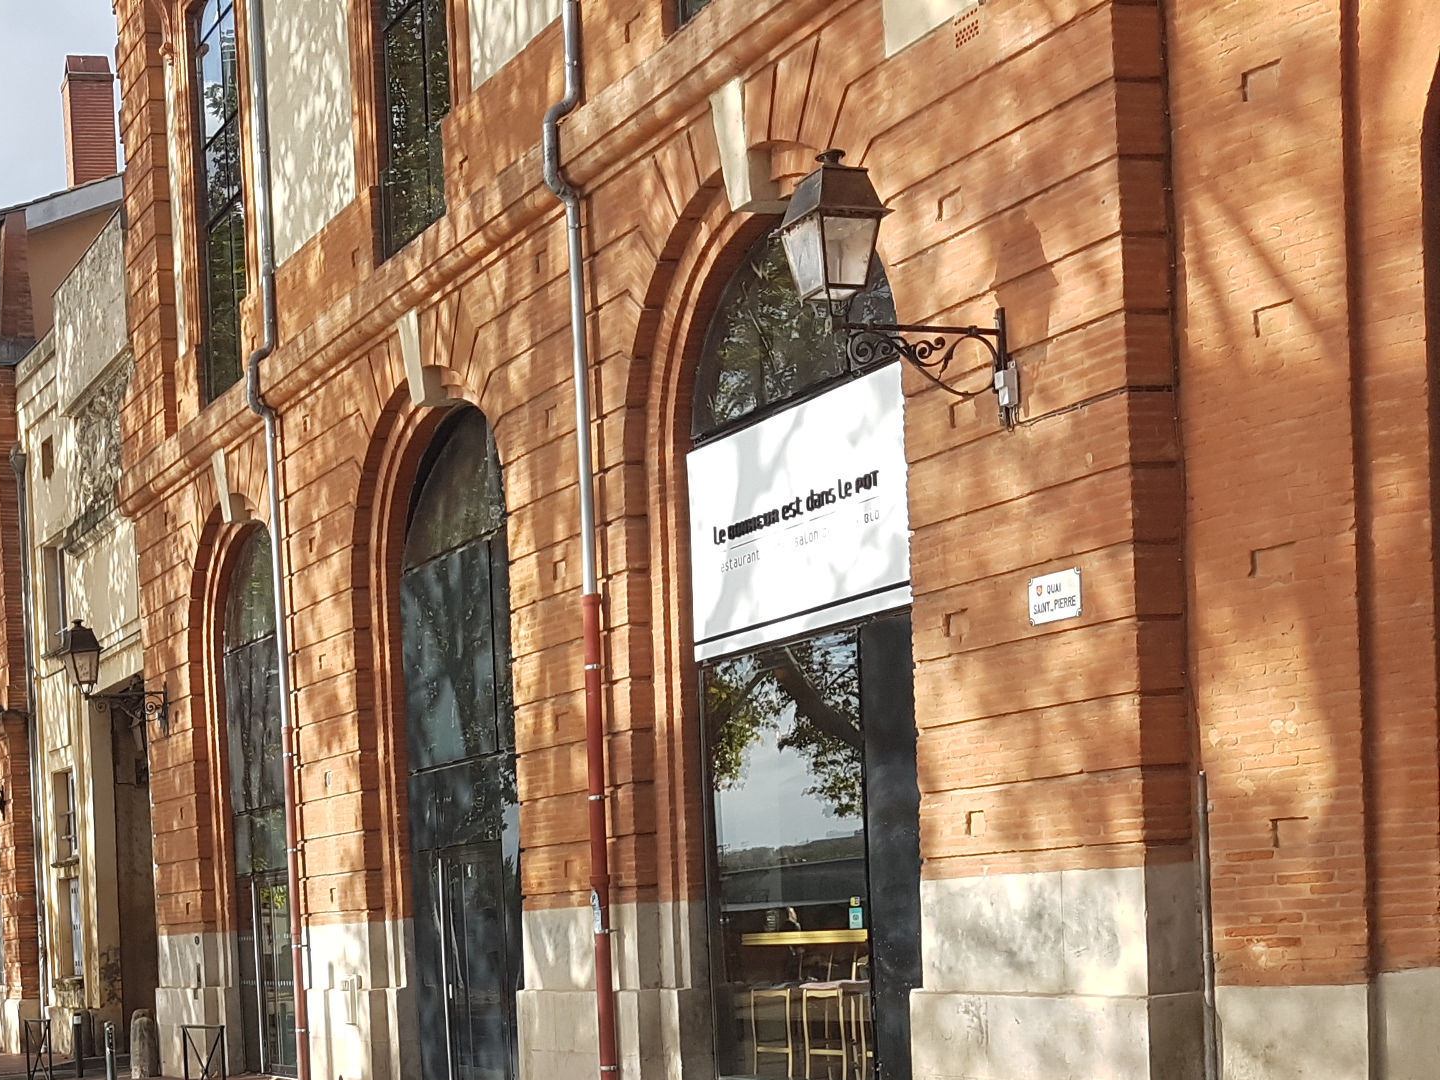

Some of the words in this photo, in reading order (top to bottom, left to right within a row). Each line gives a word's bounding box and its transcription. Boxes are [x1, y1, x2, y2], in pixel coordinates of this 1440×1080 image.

[713, 526, 726, 545] le
[781, 496, 804, 521] est
[806, 488, 837, 511] dans
[838, 479, 852, 499] le
[855, 470, 879, 494] POT
[721, 549, 760, 572] estaurant
[1047, 583, 1061, 594] QUAI
